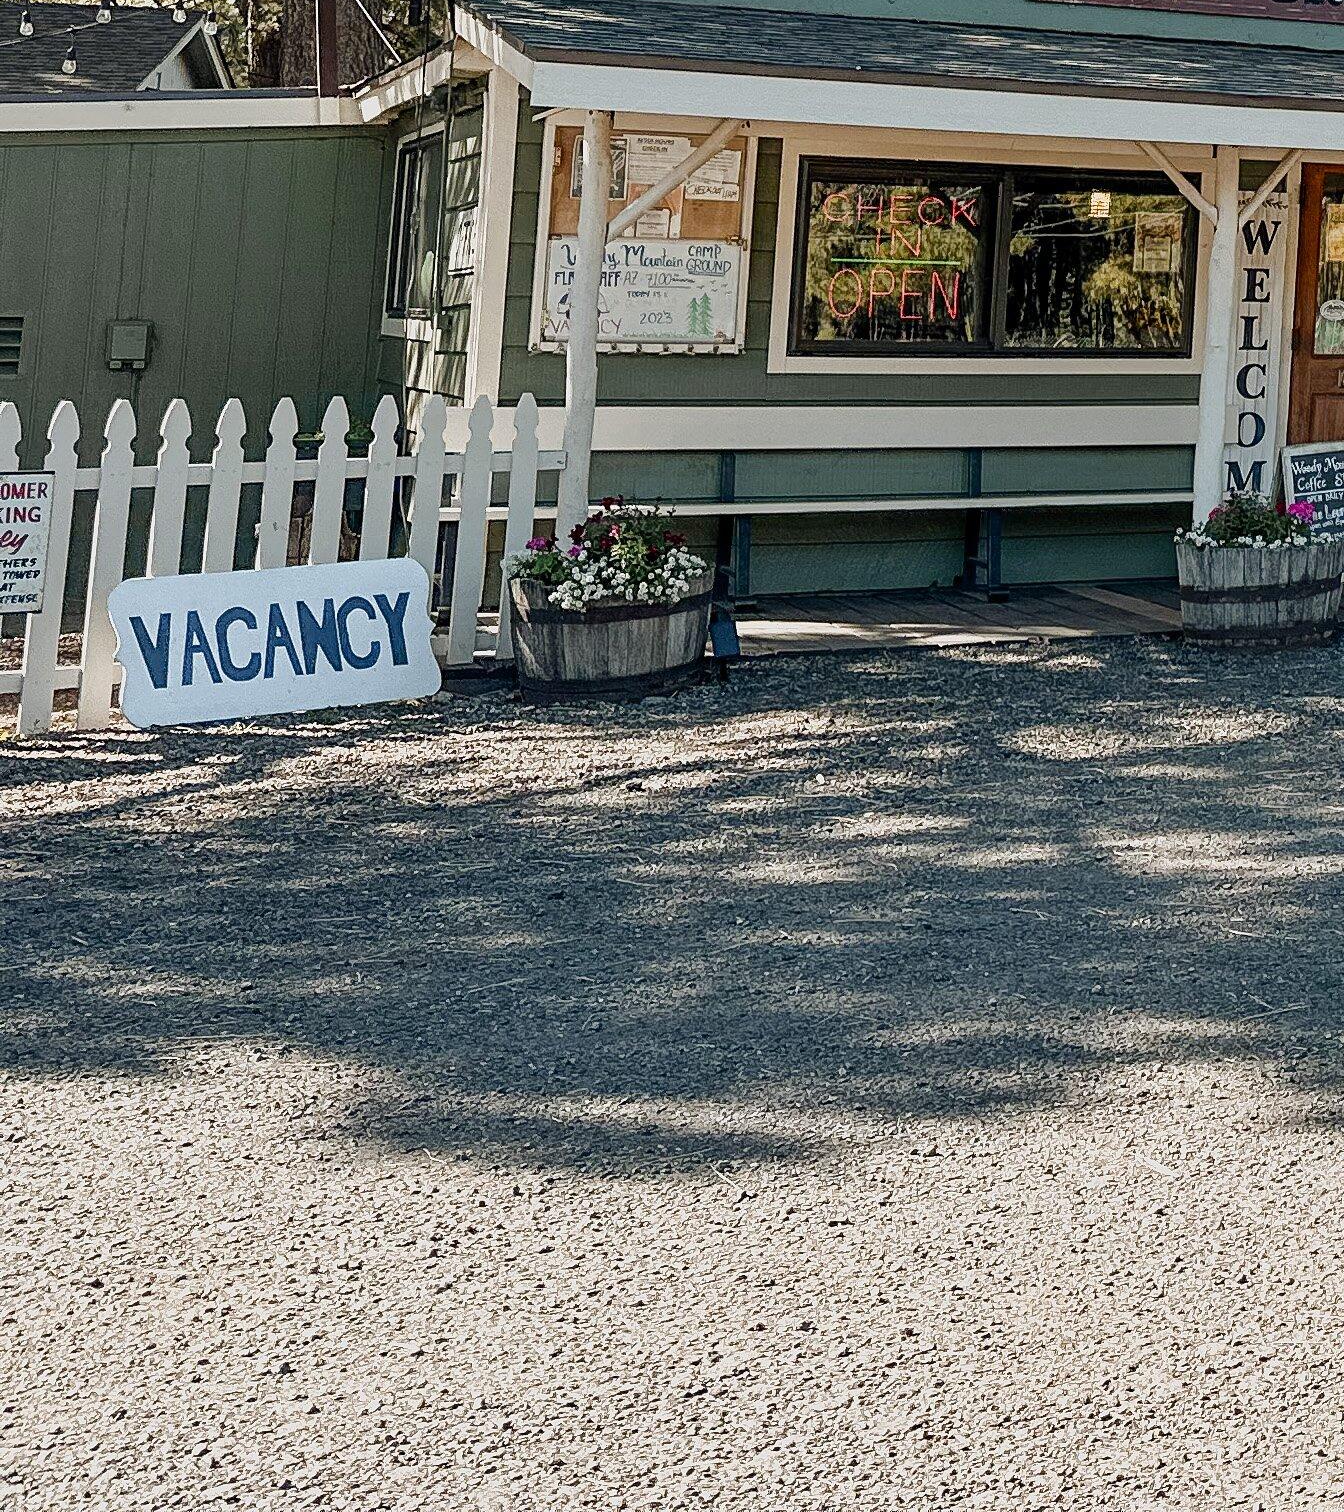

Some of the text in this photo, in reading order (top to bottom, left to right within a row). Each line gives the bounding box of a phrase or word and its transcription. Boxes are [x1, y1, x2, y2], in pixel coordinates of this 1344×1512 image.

[823, 193, 977, 227] CHECK
[688, 244, 722, 259] CAMP
[875, 227, 923, 257] IN
[686, 259, 732, 273] GROUND
[828, 268, 959, 319] OPEN
[549, 318, 623, 334] VACY
[1224, 220, 1281, 495] WELCOM
[0, 482, 48, 500] OMER
[1297, 475, 1326, 491] Coffee
[129, 592, 410, 689] VACANCY
